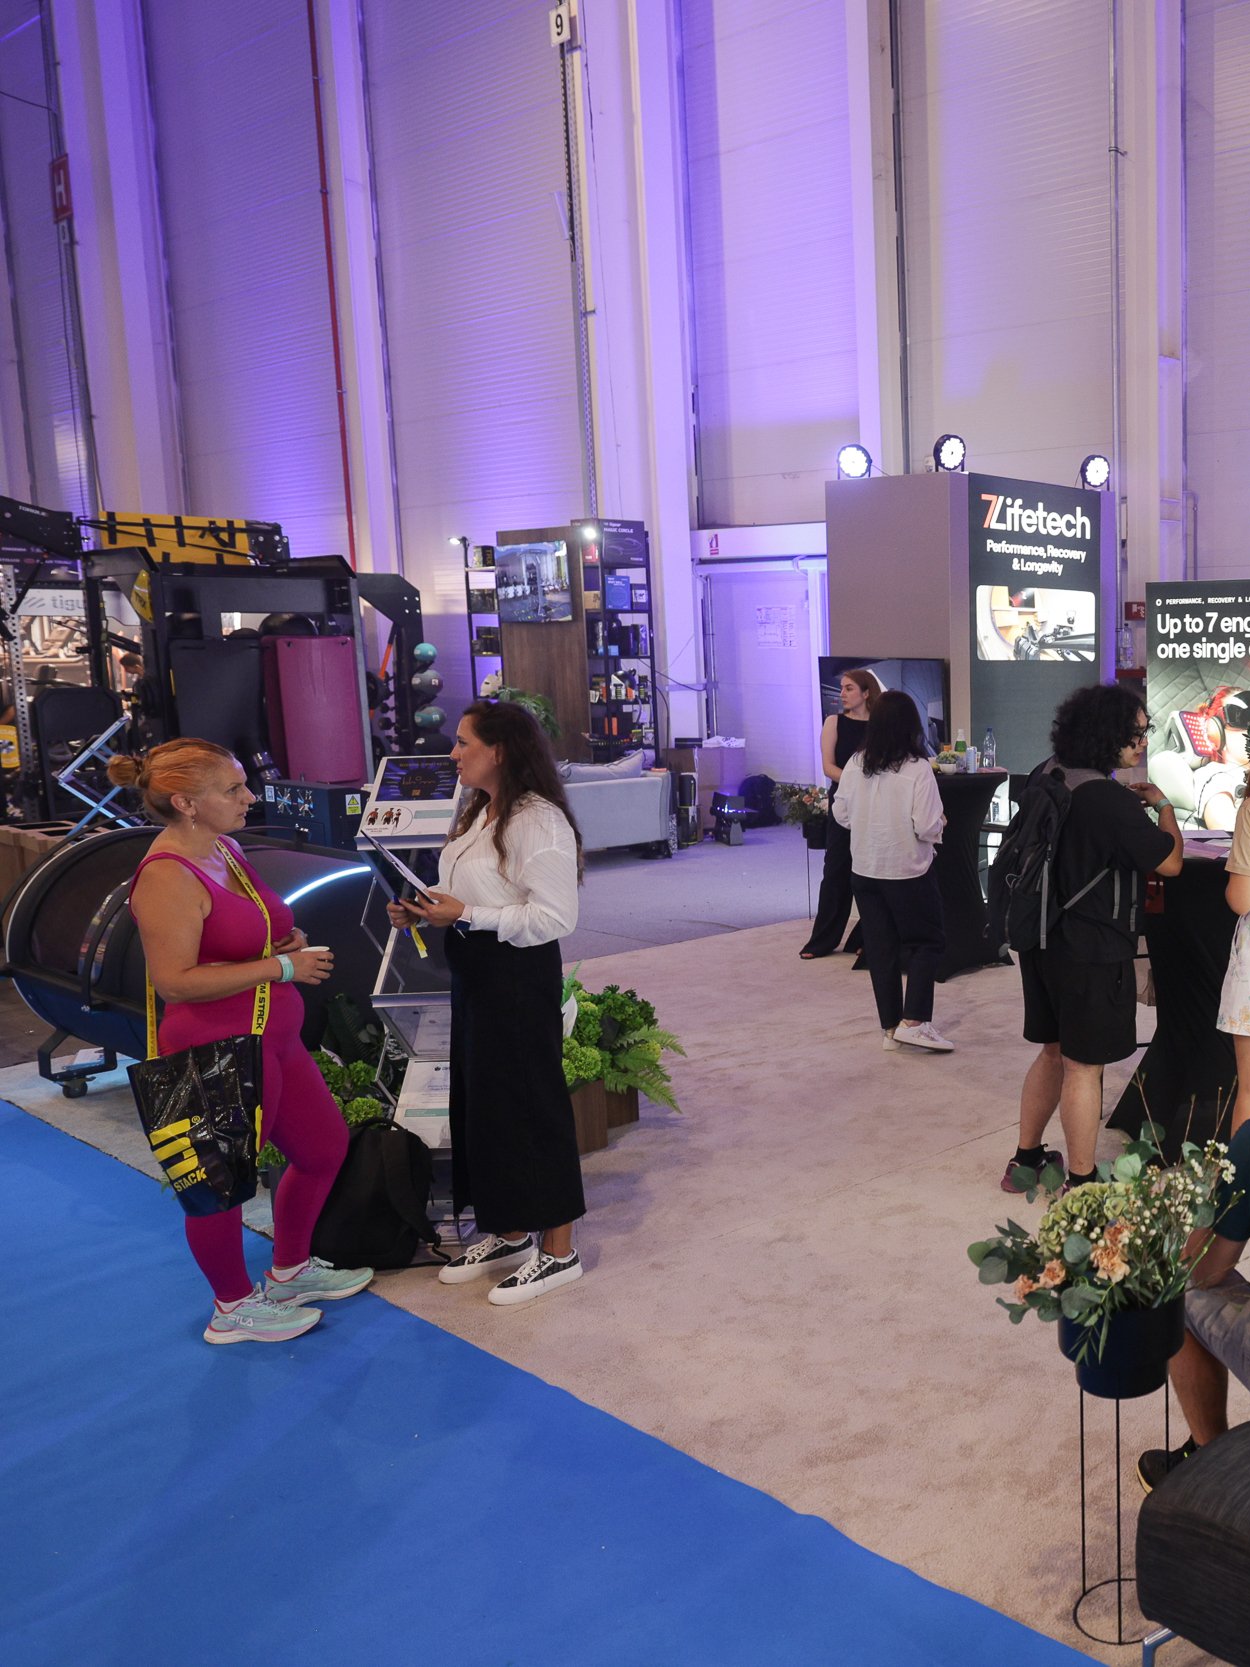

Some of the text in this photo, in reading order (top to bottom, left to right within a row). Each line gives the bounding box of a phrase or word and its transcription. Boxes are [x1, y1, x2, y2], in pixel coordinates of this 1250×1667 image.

[555, 13, 564, 37] 9
[986, 539, 1087, 563] Performance, Recovery
[1012, 558, 1064, 577] & Longevity
[1165, 597, 1205, 606] PERFORMANCE,
[1207, 596, 1236, 604] RECOVERY
[1156, 613, 1182, 639] Up
[1184, 613, 1204, 633] to
[1205, 612, 1219, 633] 7
[1156, 642, 1191, 659] one
[1193, 637, 1246, 664] single
[255, 996, 266, 1030] STACK
[173, 1167, 208, 1193] STACK
